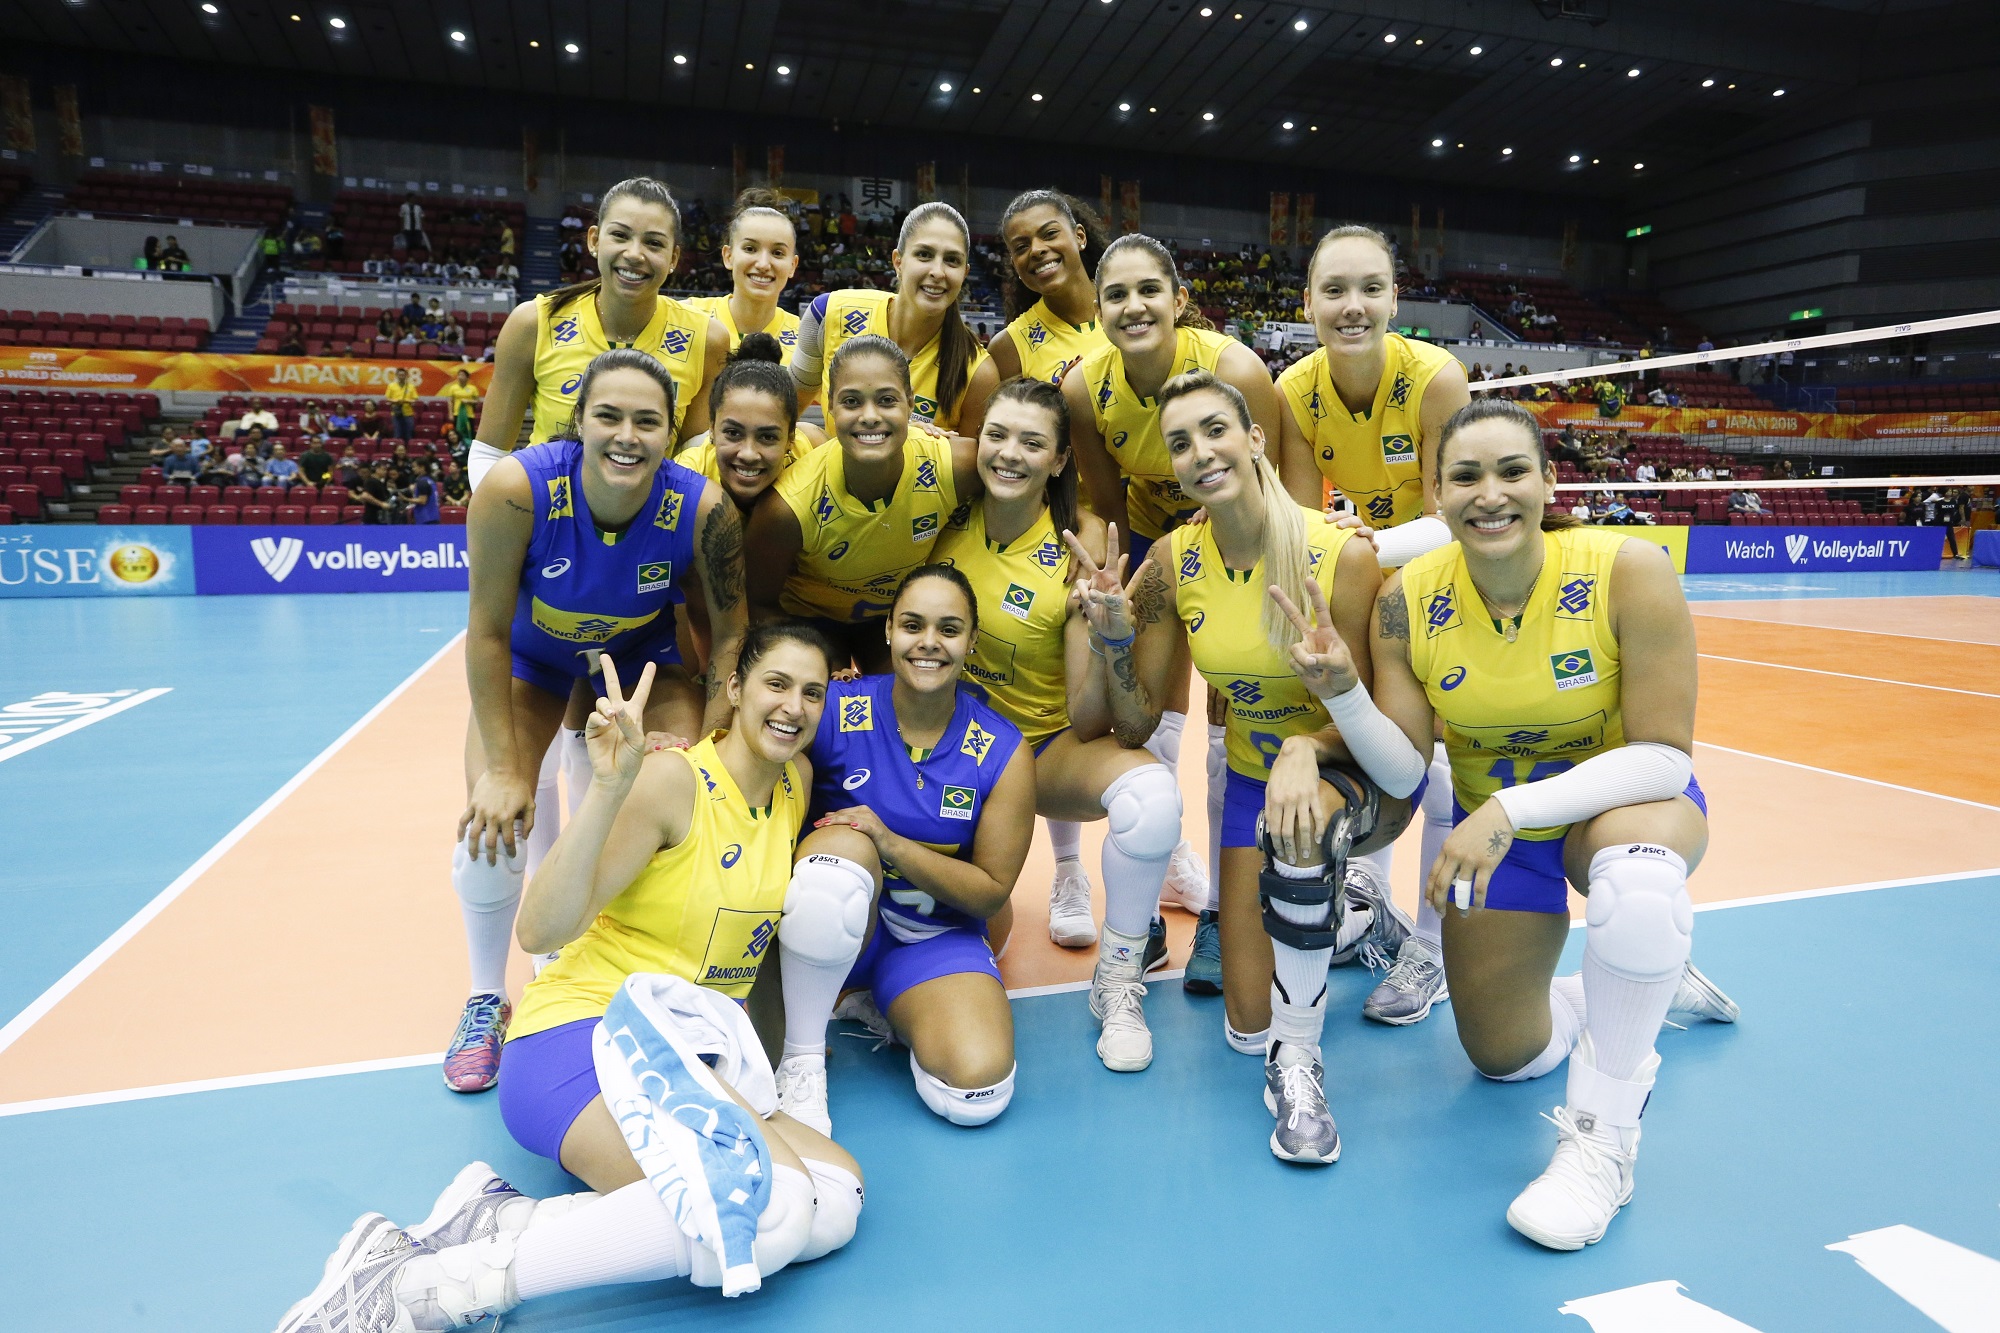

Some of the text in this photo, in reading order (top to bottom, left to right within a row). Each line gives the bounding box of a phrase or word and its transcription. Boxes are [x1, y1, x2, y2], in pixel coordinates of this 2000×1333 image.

[860, 178, 893, 209] 東
[7, 370, 49, 380] WORLD
[269, 364, 423, 386] JAPAN 208
[1725, 415, 1797, 430] JAPAN 2018
[1385, 454, 1415, 463] BRASIL
[913, 530, 938, 542] BRASIL
[1725, 540, 1910, 563] Watch Volleyball TV
[639, 581, 668, 592] BRASIL
[1001, 602, 1026, 618] BRASIL
[970, 663, 1008, 682] BRASIL
[1557, 674, 1596, 689] BRASIL
[1263, 703, 1311, 720] BRASIL
[941, 808, 970, 818] BRASIL
[1641, 846, 1666, 856] asics
[818, 856, 840, 864] asics
[705, 965, 743, 980] BANCO
[975, 1089, 995, 1098] asics
